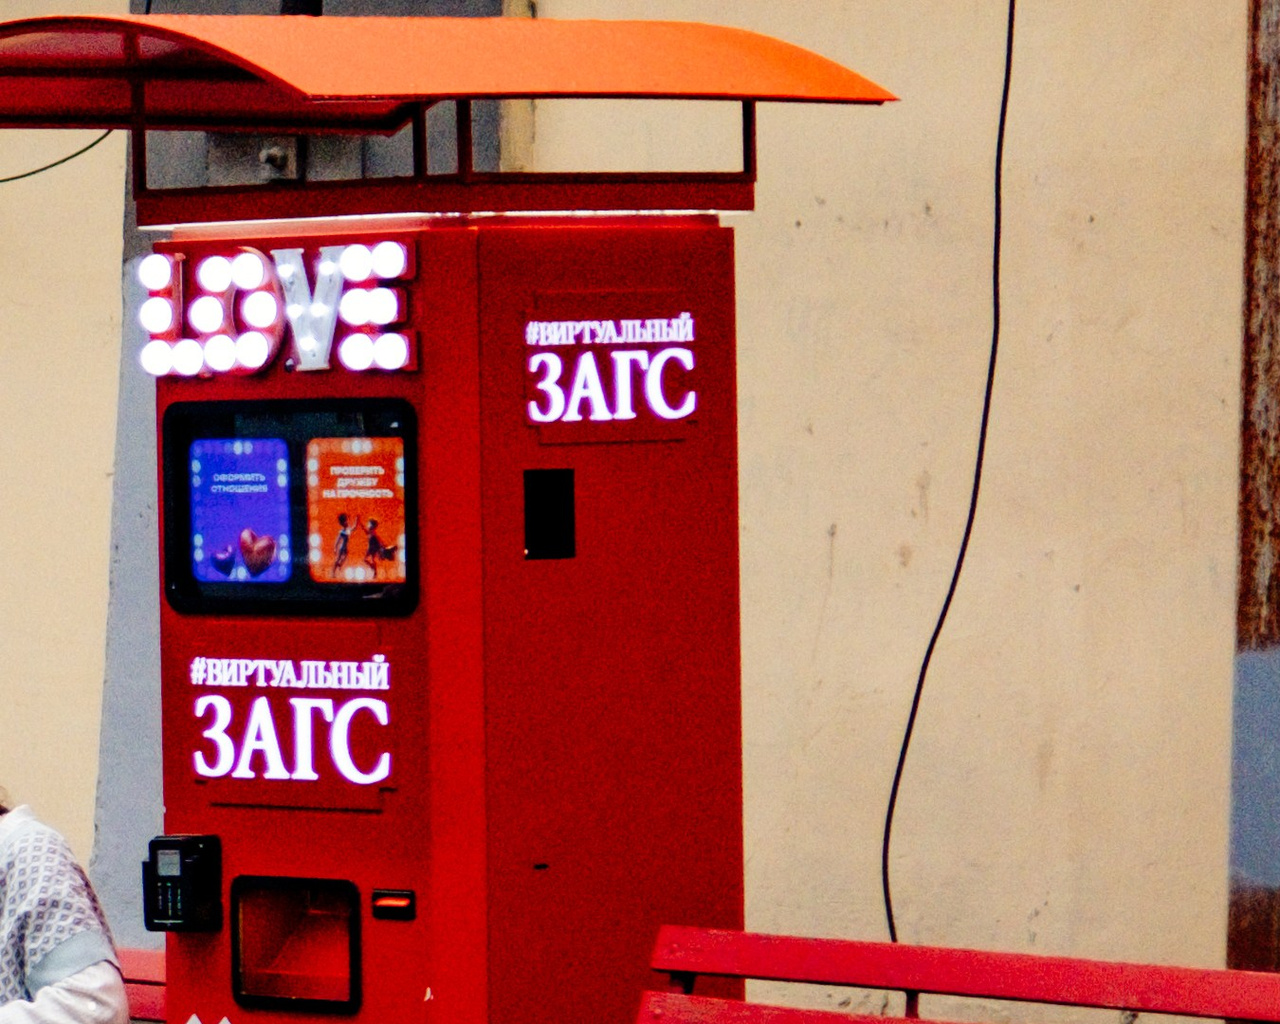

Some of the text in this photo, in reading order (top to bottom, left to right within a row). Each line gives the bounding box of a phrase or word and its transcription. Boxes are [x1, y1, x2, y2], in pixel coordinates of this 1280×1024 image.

[138, 240, 416, 377] LOVE
[526, 312, 694, 346] #ВИРТУАЛЬНЫЙ
[528, 347, 697, 422] ЗАГС
[191, 654, 390, 690] #ВИРТУАЛЬНЫЙ
[194, 694, 391, 785] ЗАГС
